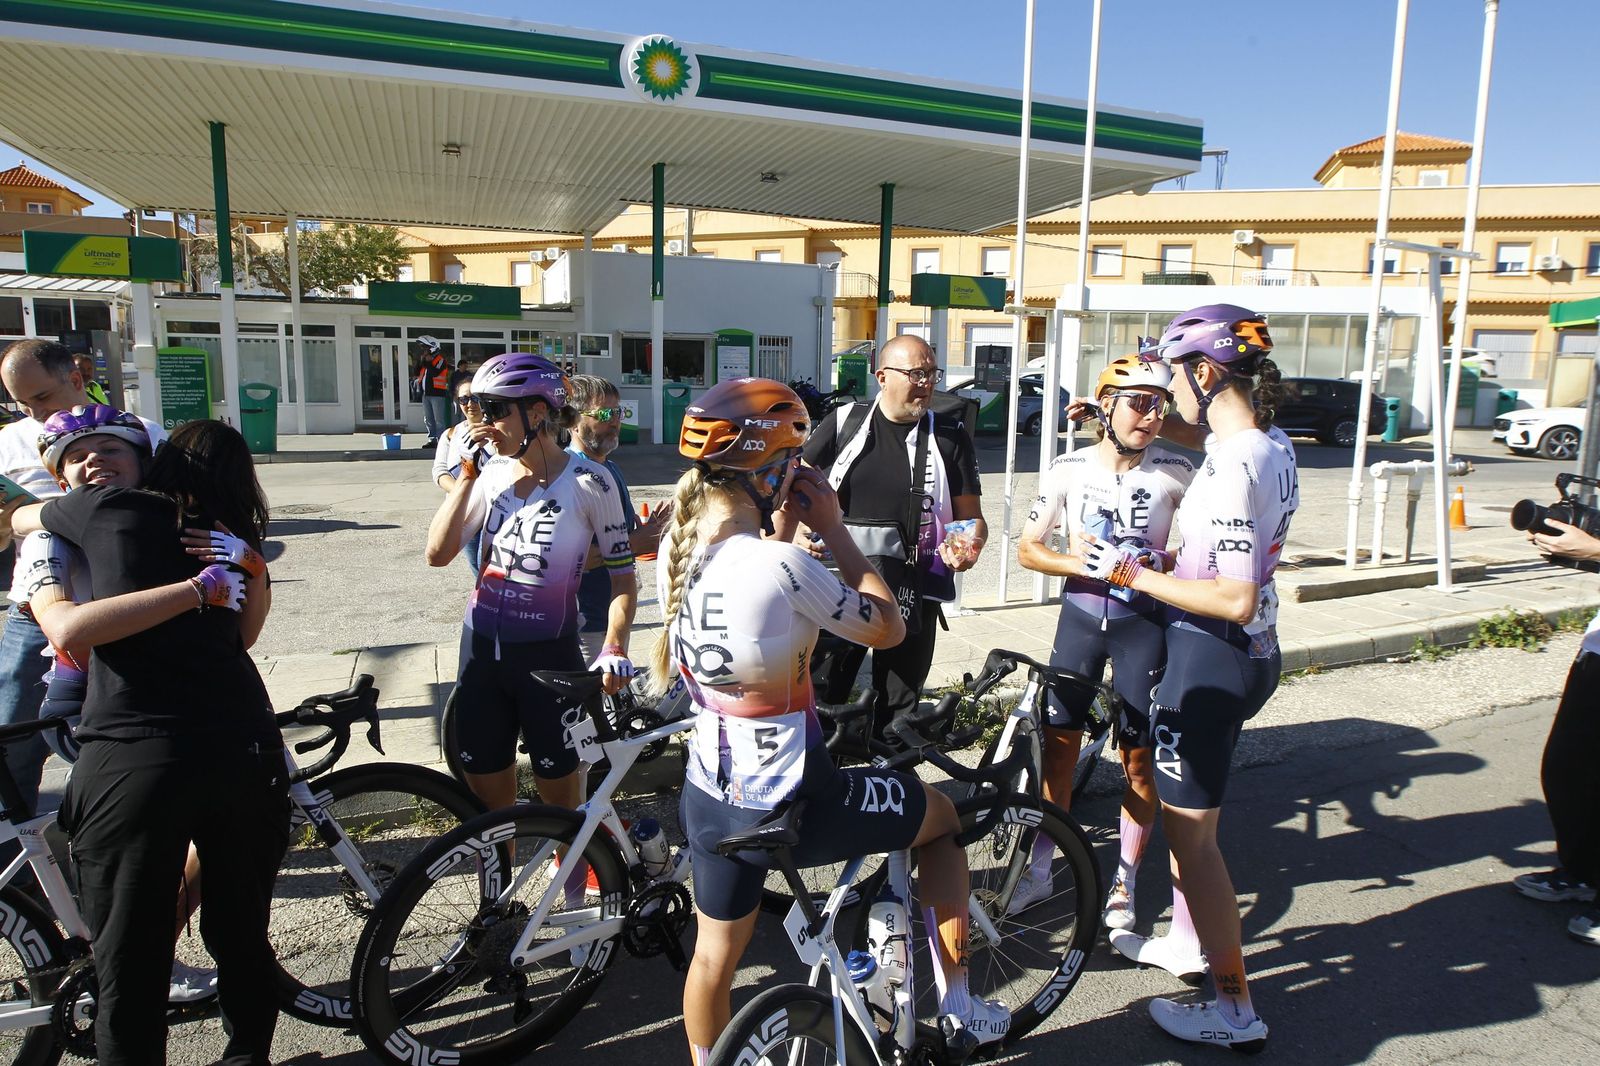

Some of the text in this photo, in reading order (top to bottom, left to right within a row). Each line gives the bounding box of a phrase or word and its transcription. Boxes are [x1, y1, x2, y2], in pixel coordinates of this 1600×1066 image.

[426, 289, 473, 305] shop
[1213, 337, 1233, 349] ADQ
[540, 367, 561, 379] MET
[744, 419, 781, 429] MET
[742, 439, 766, 451] ADQ
[1054, 456, 1087, 465] Analog
[1159, 457, 1193, 472] Analog
[486, 509, 555, 546] UAE
[1216, 539, 1253, 554] ADQ
[898, 586, 915, 604] UAE
[519, 611, 546, 621] IHC
[581, 735, 593, 748] 2
[754, 726, 779, 767] 5
[1155, 724, 1183, 782] ADQ
[860, 776, 906, 816] ADQ
[19, 828, 38, 836] UAE
[885, 913, 895, 933] ADQ
[797, 926, 808, 946] 5
[1200, 1030, 1234, 1040] SIDI
